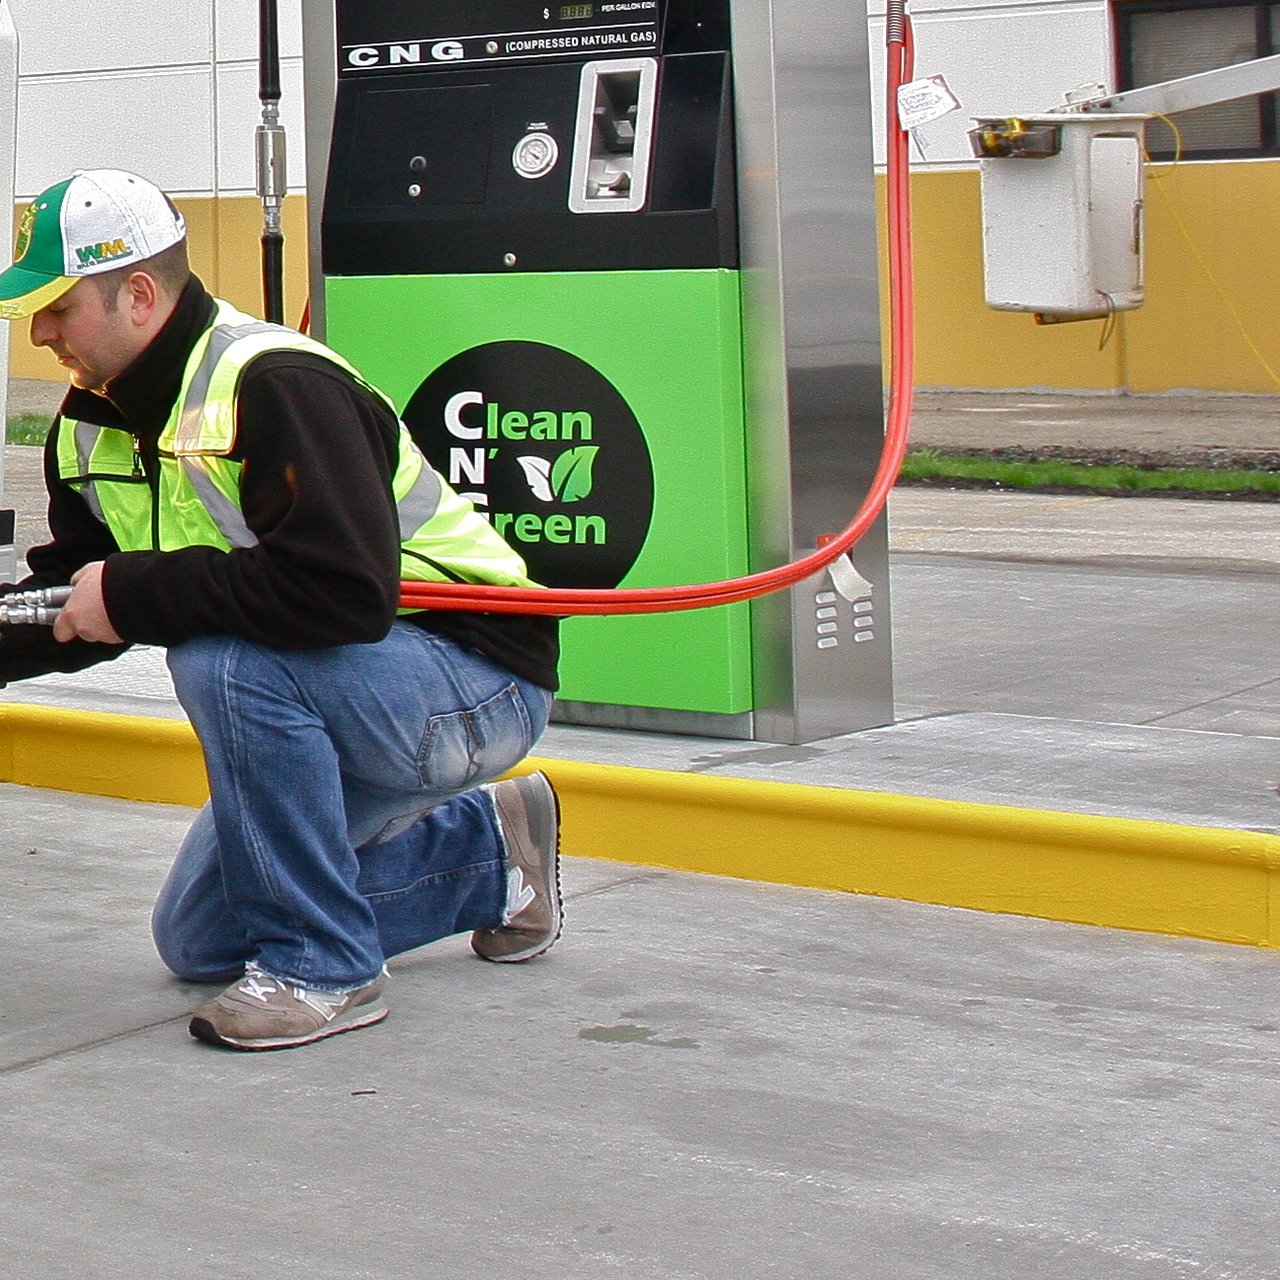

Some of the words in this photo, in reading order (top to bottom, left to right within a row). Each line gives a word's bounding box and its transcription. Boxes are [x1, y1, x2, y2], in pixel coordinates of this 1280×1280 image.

[543, 7, 550, 20] $
[348, 40, 465, 67] CNG
[505, 36, 579, 53] (COMPRESSED
[580, 32, 628, 47] NATURAL
[630, 31, 657, 43] GAS)
[444, 391, 593, 440] Clean
[458, 492, 607, 545] reen
